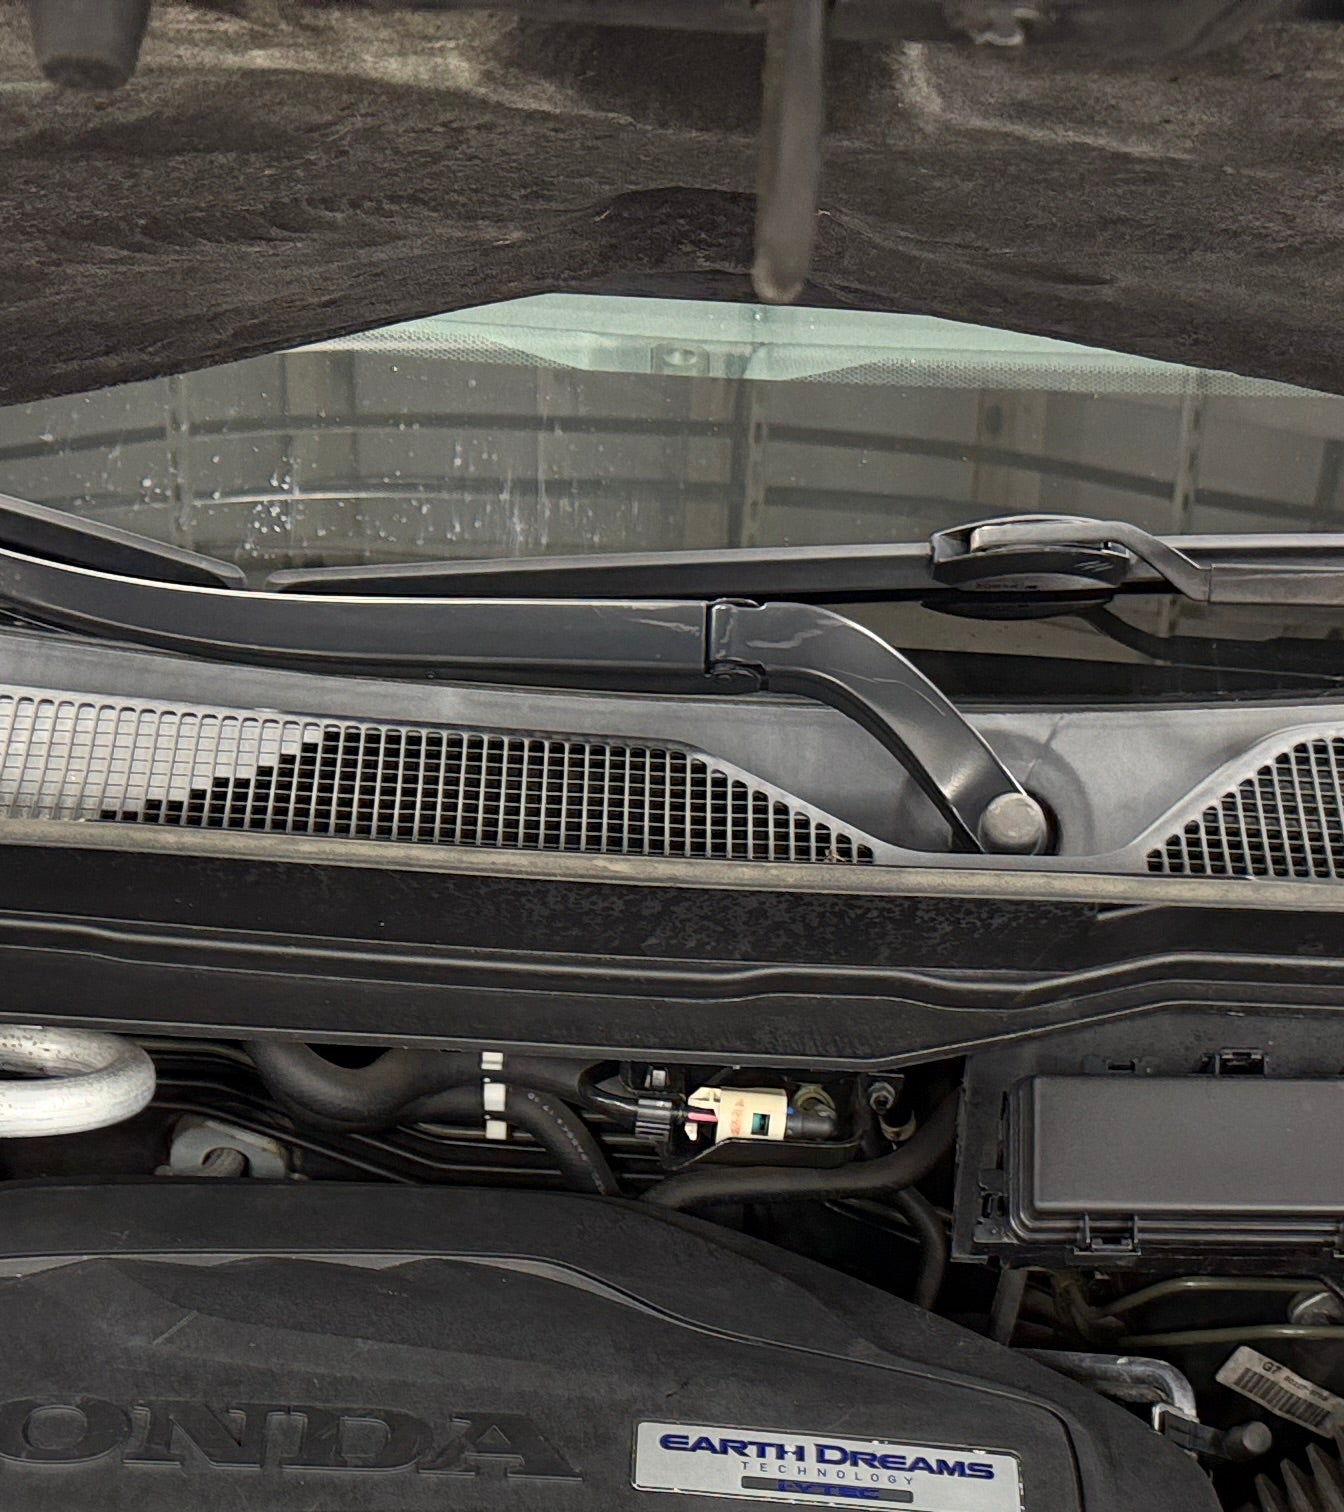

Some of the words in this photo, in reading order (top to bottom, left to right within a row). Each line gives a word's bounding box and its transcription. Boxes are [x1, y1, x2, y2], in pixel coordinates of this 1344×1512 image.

[659, 1433, 805, 1462] EARTH
[814, 1442, 995, 1481] DREAMS
[741, 1461, 914, 1486] TECHNOLOGY
